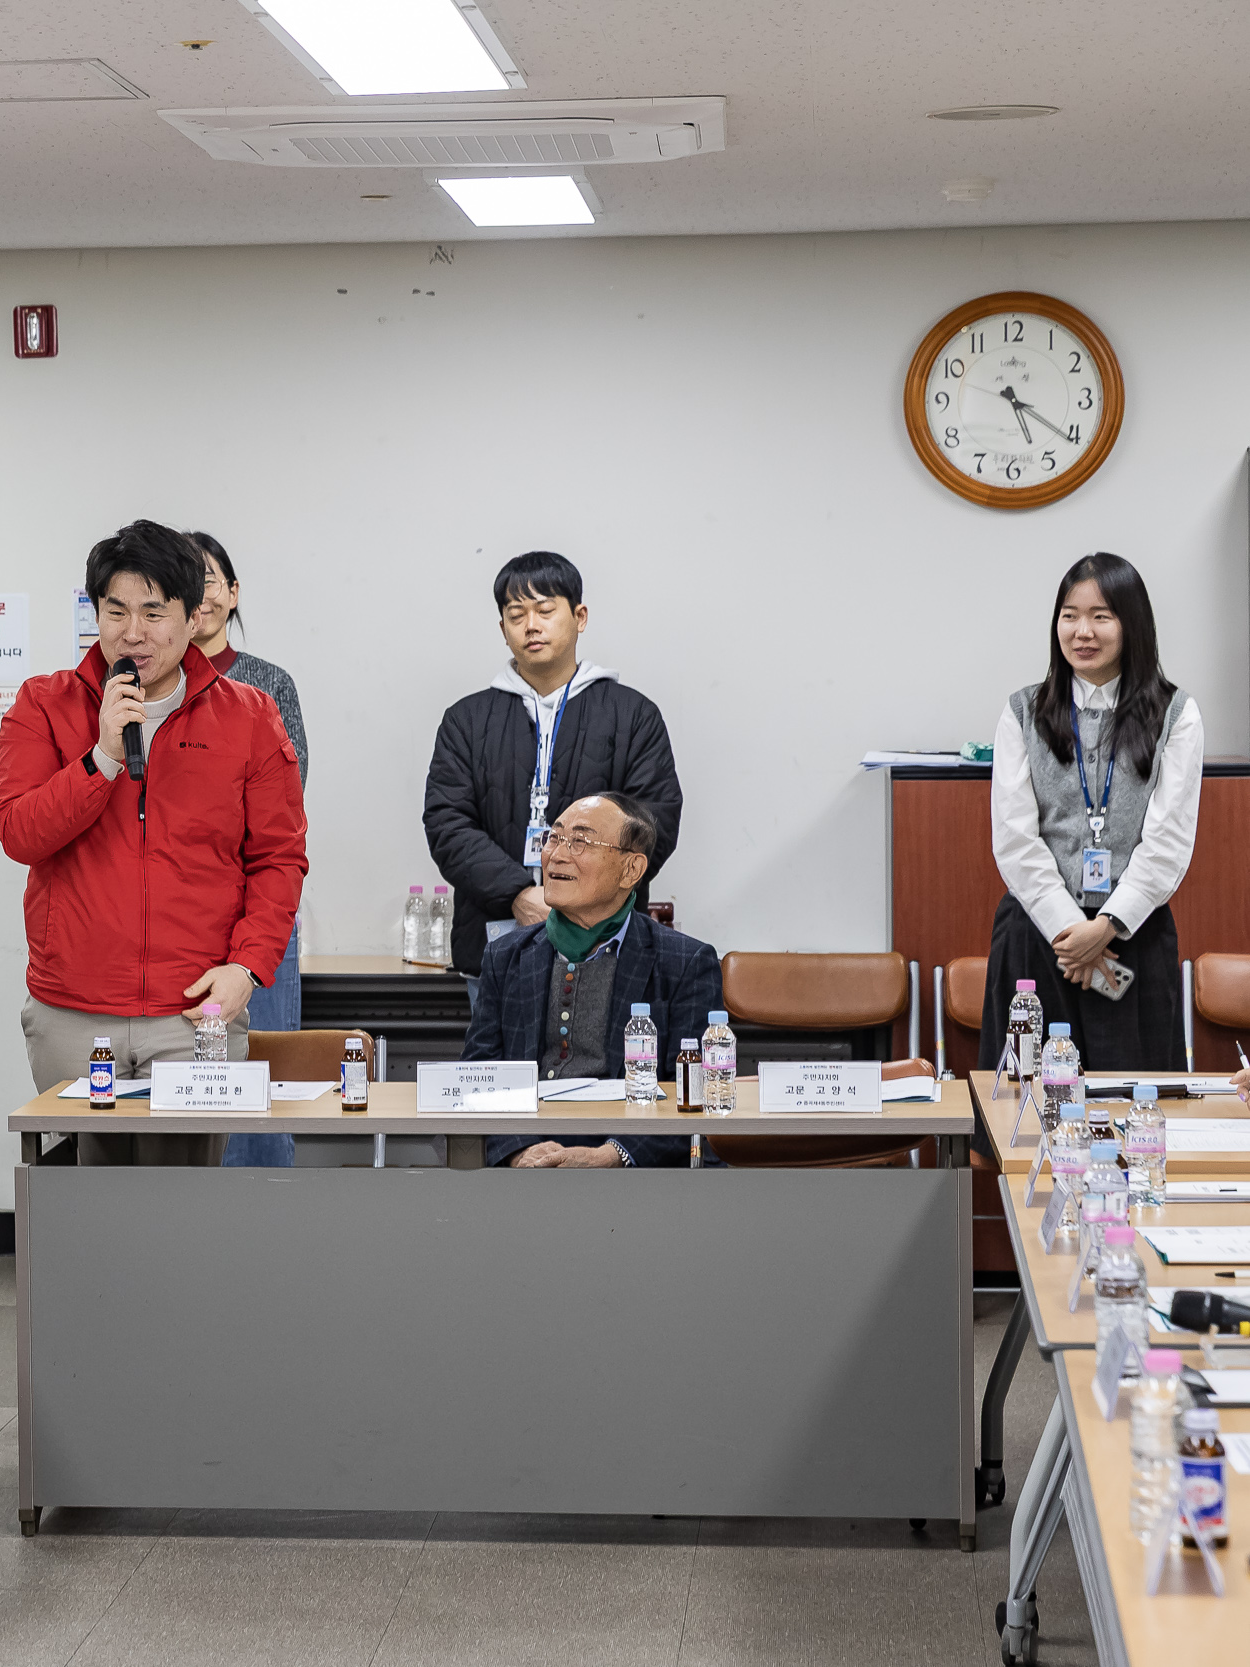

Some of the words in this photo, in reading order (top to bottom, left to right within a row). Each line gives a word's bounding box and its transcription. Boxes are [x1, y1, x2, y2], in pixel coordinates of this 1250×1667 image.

[1003, 320, 1024, 343] 12
[1048, 328, 1054, 351] 1
[970, 332, 985, 354] 11
[944, 358, 965, 379] 10
[1068, 352, 1081, 374] 2
[934, 391, 950, 413] 9
[1077, 387, 1093, 411] 3
[944, 426, 960, 448] 8
[1067, 424, 1081, 445] 4
[973, 453, 987, 474] 7
[1005, 459, 1021, 481] 6
[1040, 450, 1056, 472] 5
[175, 1086, 193, 1095] 고문
[442, 1087, 461, 1097] 고문
[785, 1085, 805, 1095] 고문
[816, 1086, 826, 1095] 고
